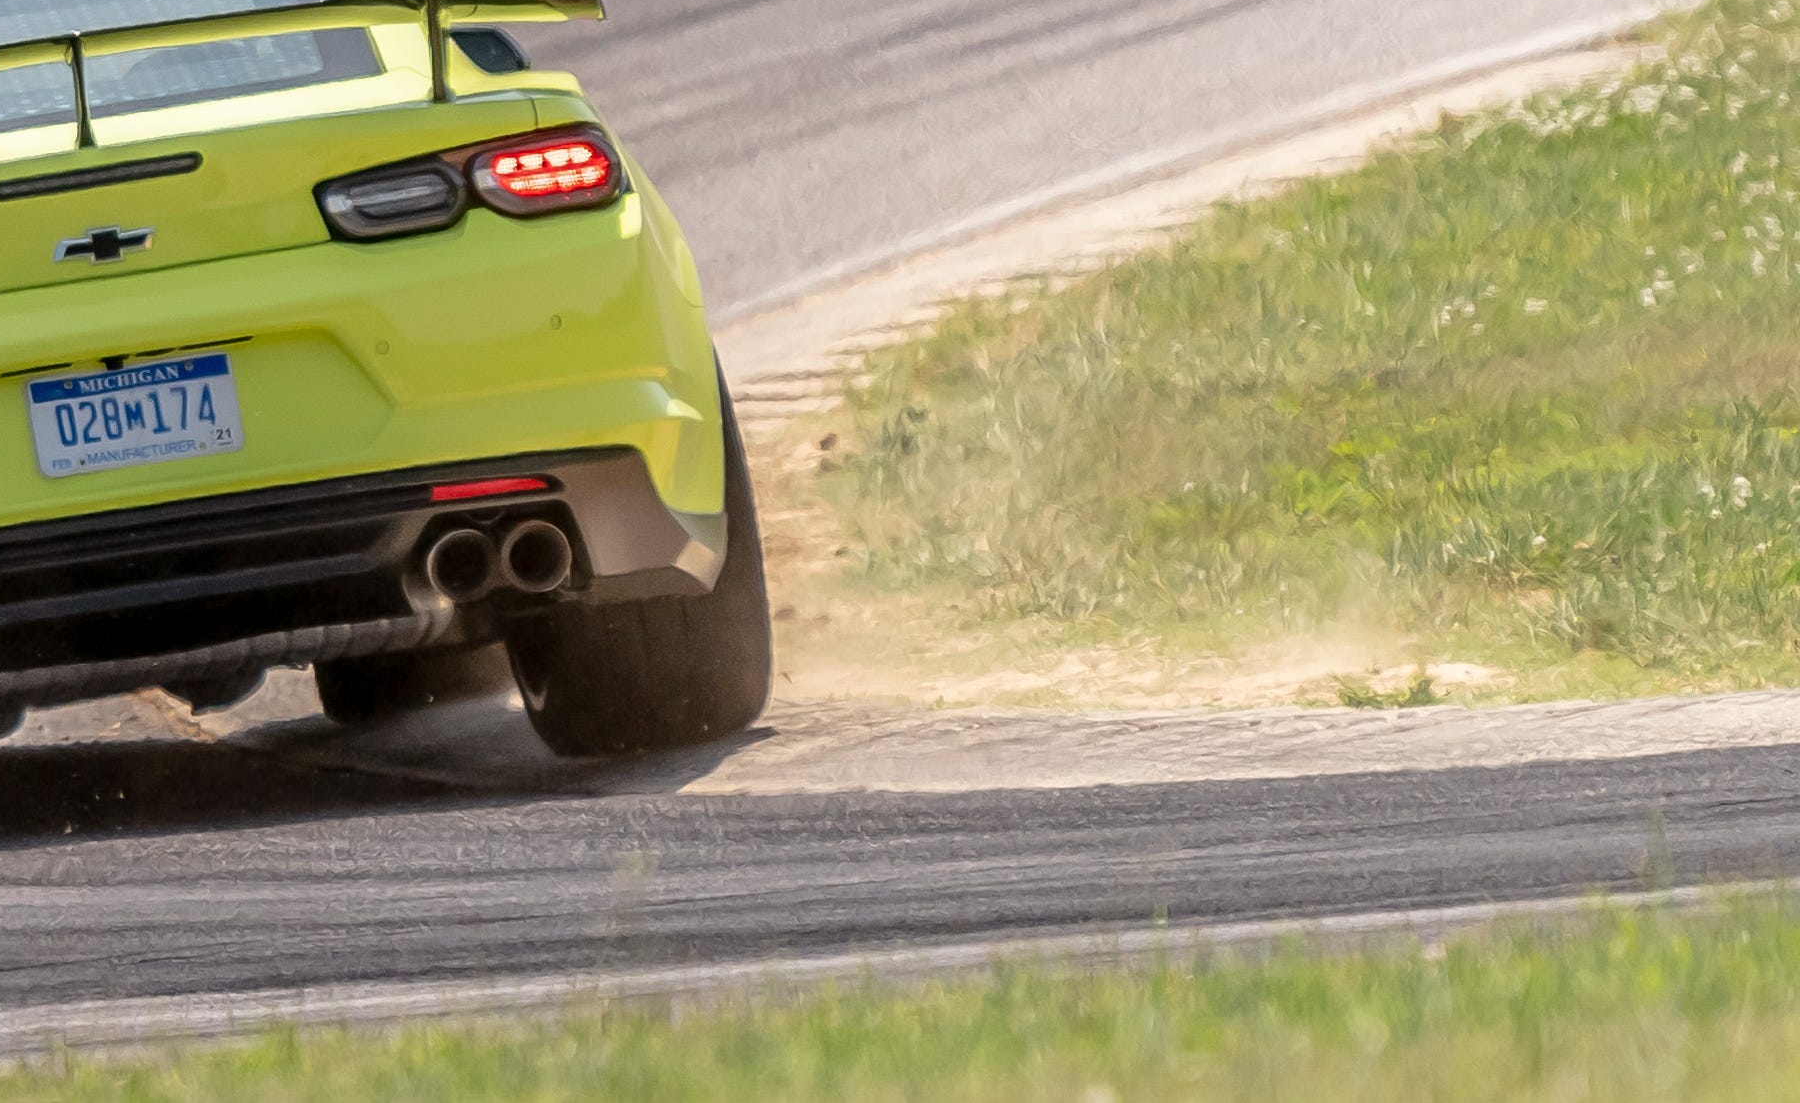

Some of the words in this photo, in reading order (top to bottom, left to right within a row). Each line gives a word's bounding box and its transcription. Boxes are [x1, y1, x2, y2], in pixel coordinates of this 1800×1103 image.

[78, 365, 180, 394] MICHIGAN
[54, 382, 216, 447] 028M174
[215, 427, 232, 441] 21
[87, 439, 196, 464] MANUFACTURER
